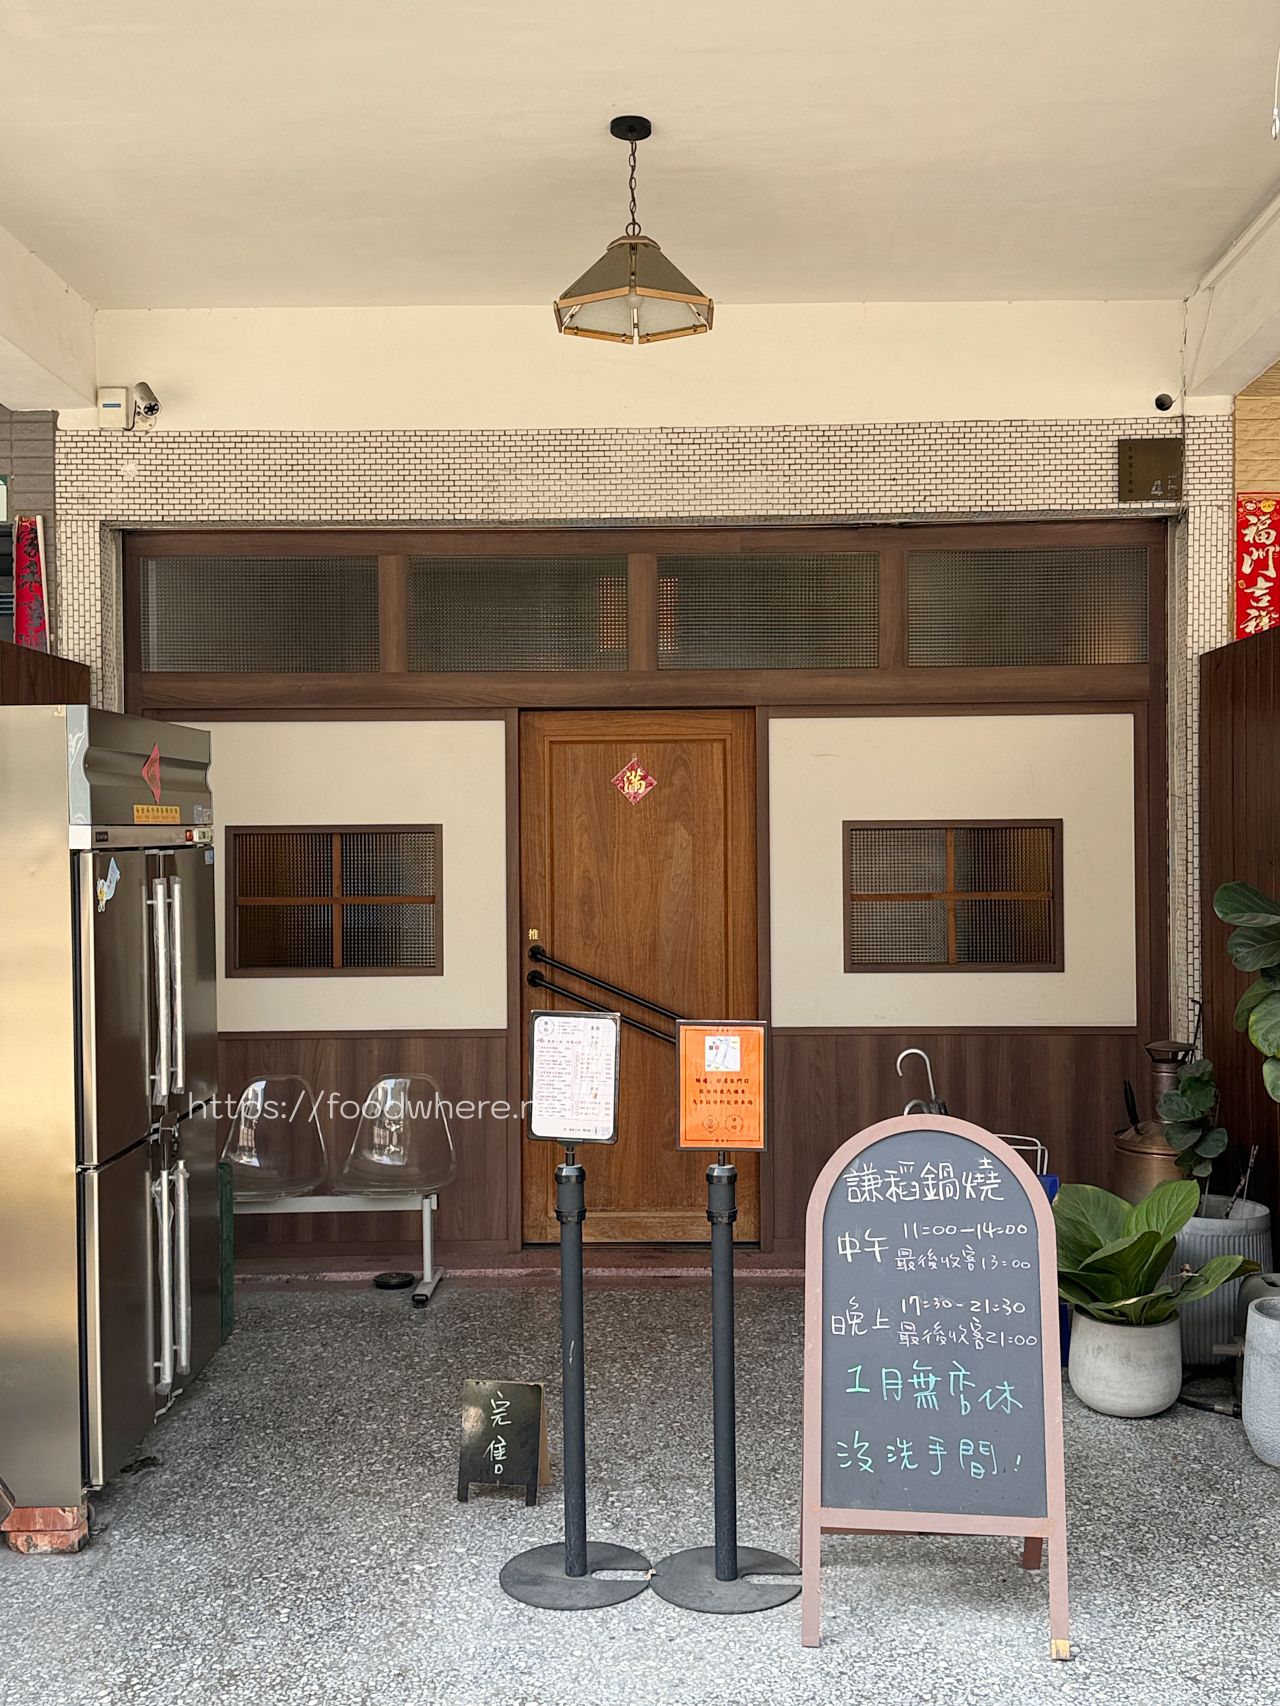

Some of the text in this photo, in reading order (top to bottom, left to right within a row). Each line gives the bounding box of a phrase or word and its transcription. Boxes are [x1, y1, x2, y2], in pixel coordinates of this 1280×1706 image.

[623, 767, 647, 794] 滿
[527, 928, 540, 941] 推
[842, 1155, 1004, 1203] 謙稻鍋燒
[837, 1227, 890, 1263] 中午
[903, 1221, 1028, 1240] 11:00-14:00
[831, 1295, 891, 1337] 晚上
[482, 1390, 513, 1475] 完售
